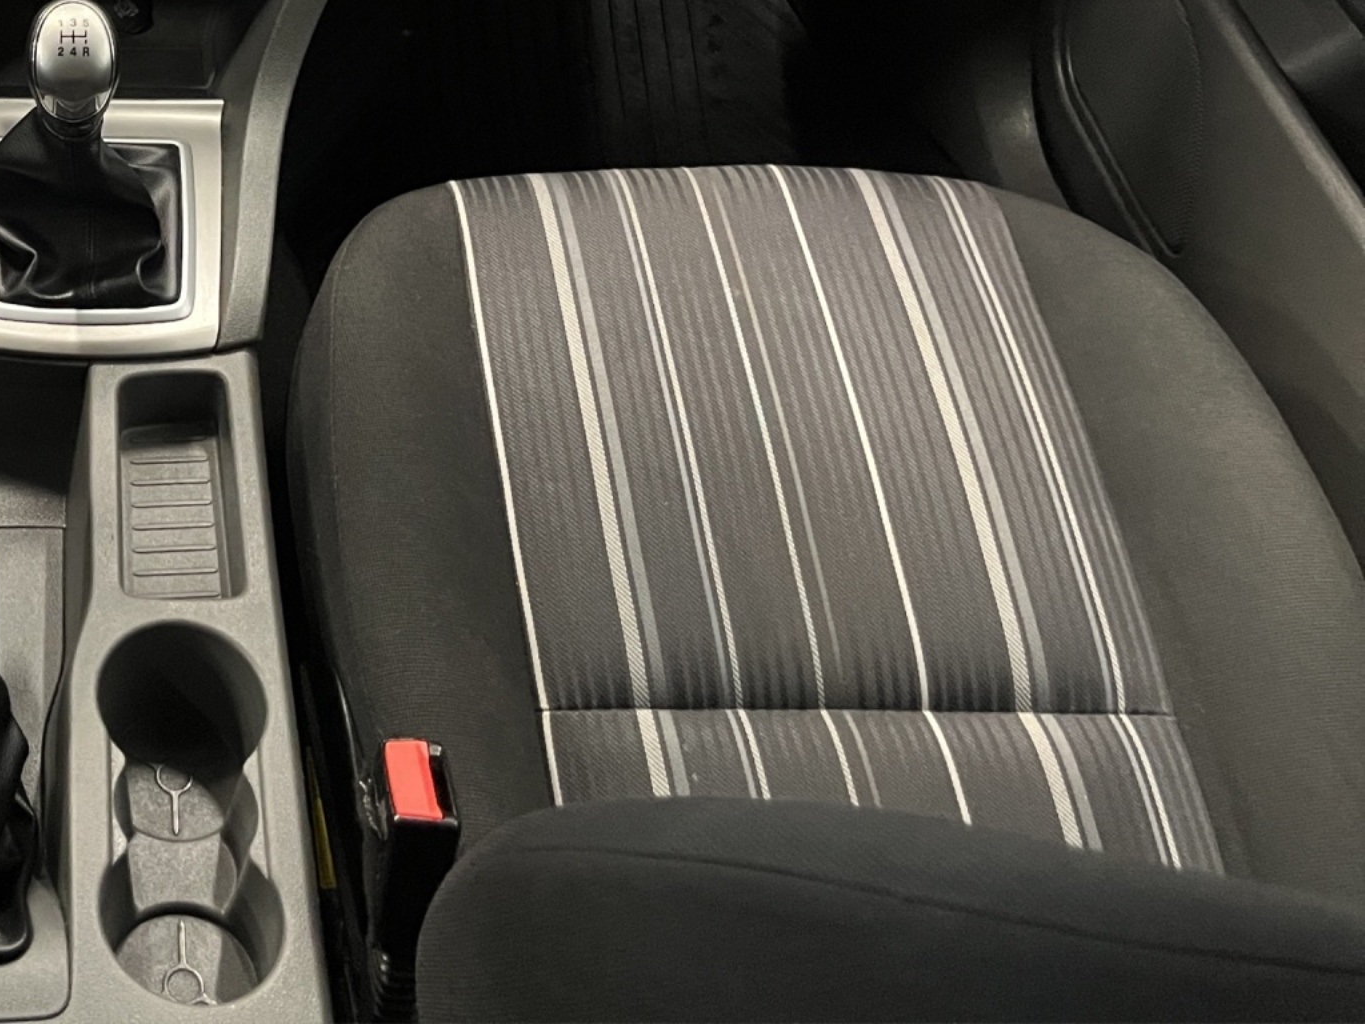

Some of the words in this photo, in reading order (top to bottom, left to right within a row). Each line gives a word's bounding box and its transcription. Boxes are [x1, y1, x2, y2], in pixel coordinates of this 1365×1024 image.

[69, 18, 77, 28] 3
[82, 18, 90, 28] 5
[57, 46, 65, 57] 2
[69, 46, 77, 57] 4
[82, 46, 90, 57] R
